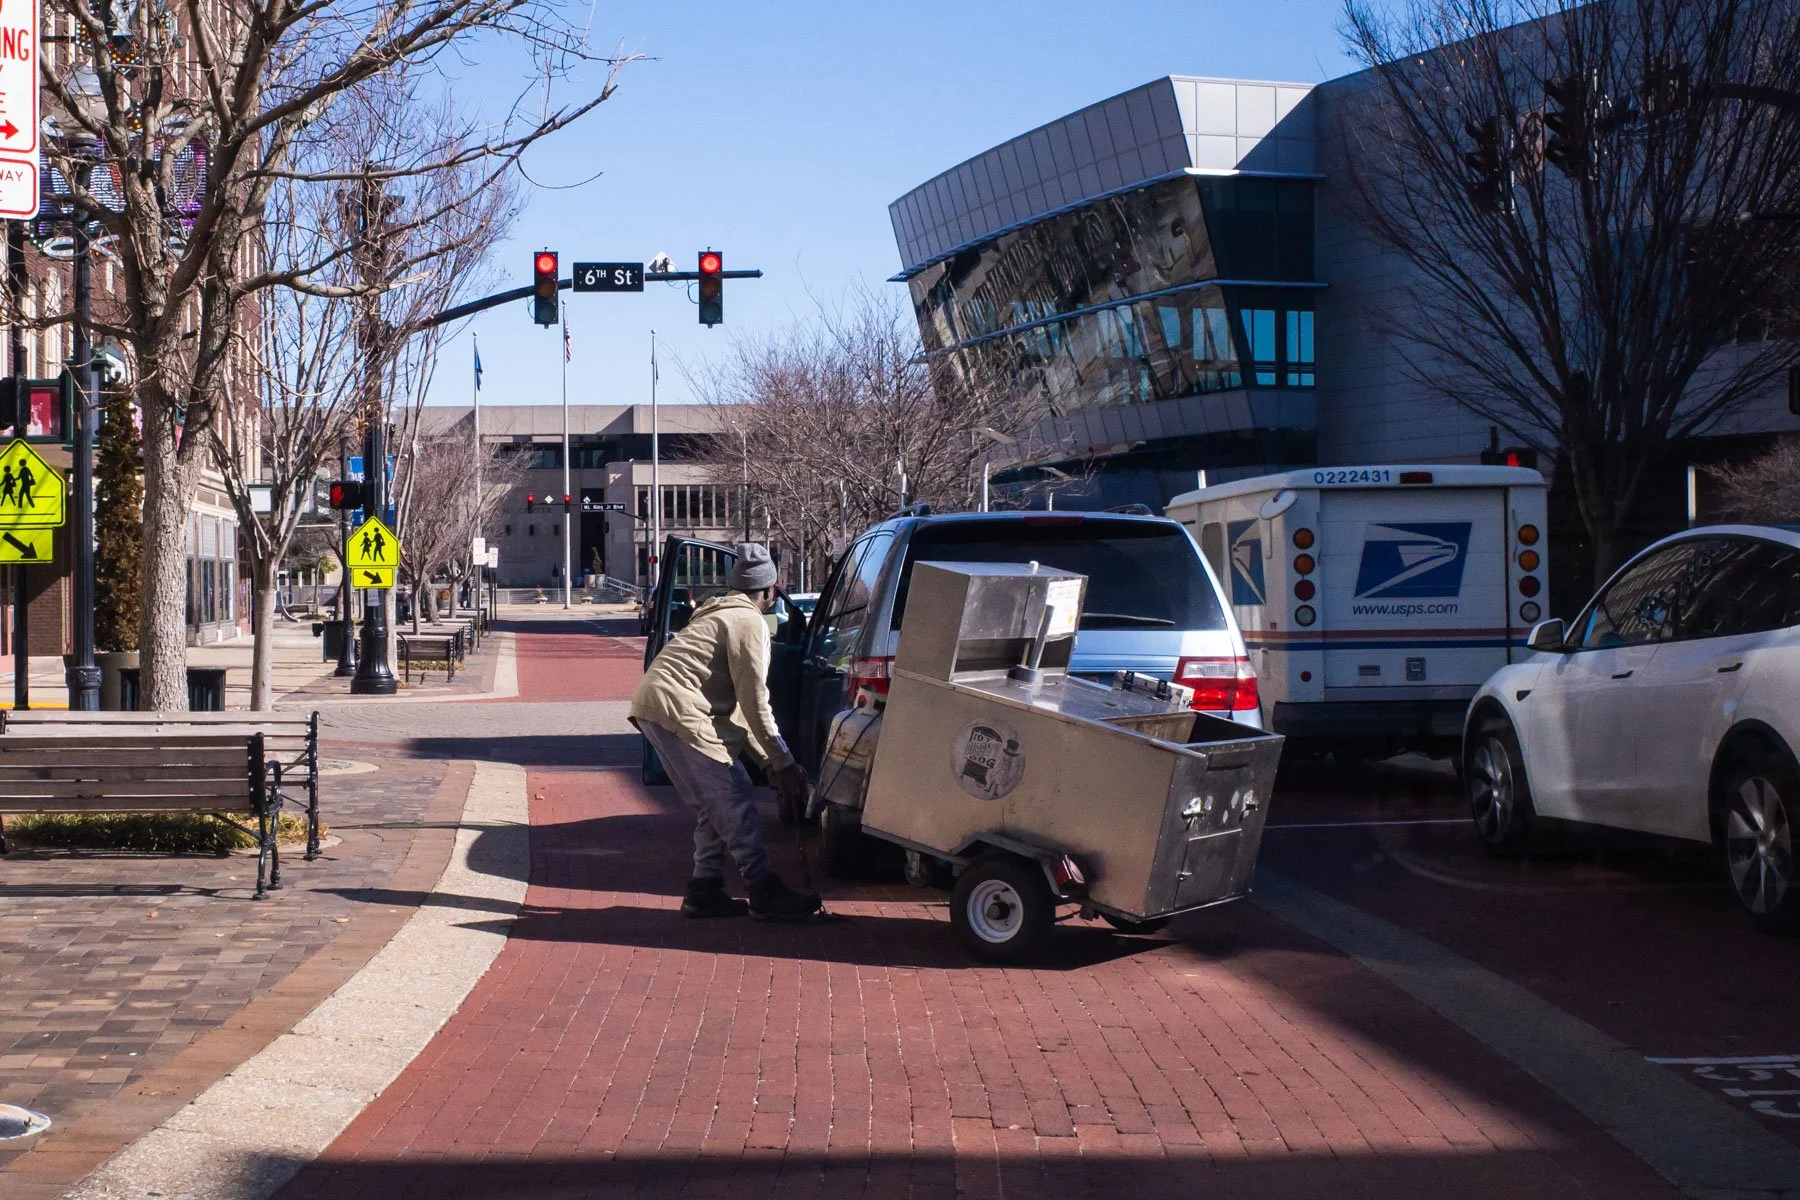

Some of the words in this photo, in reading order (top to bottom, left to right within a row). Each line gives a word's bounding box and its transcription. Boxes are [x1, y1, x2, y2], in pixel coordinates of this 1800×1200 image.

[614, 269, 632, 285] St
[1314, 469, 1390, 484] 0222431
[1352, 604, 1458, 617] www.usps.com
